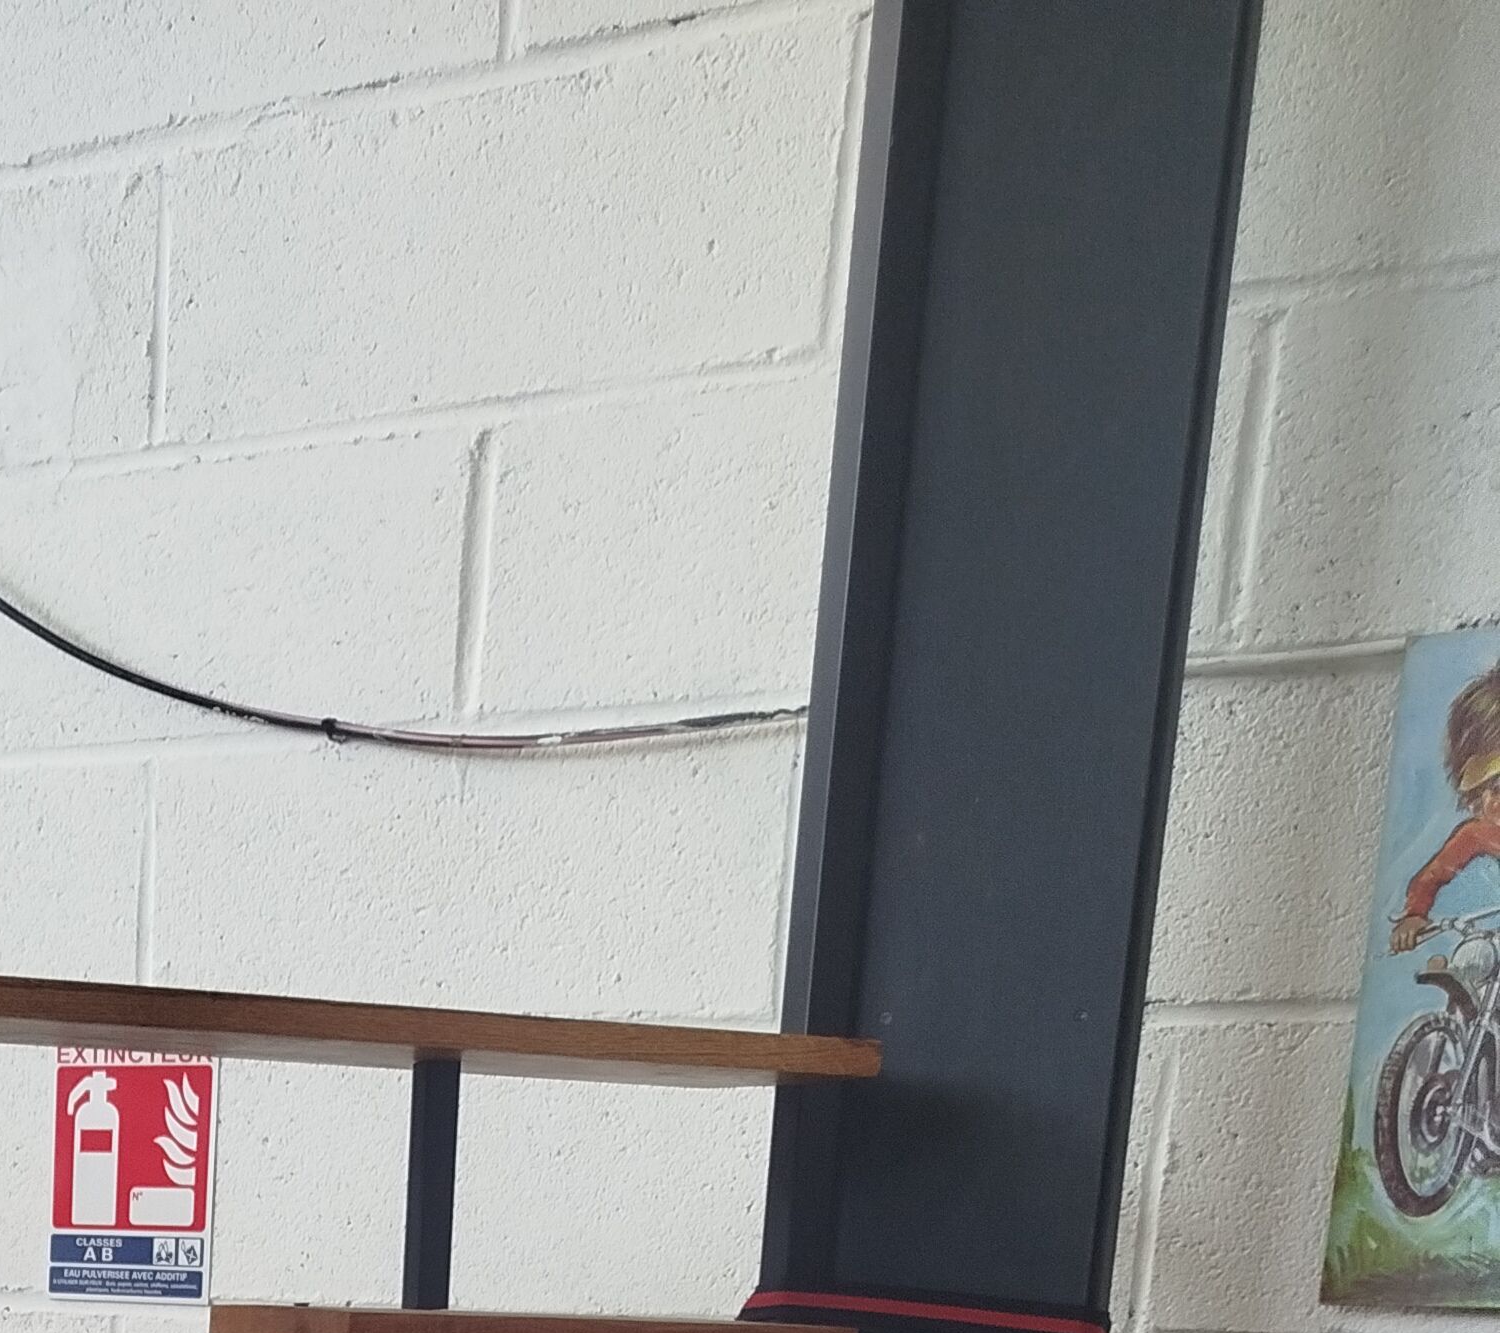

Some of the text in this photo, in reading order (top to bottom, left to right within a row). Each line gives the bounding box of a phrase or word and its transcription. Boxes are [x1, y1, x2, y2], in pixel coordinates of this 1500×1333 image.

[76, 1237, 123, 1248] CLASSES
[83, 1247, 114, 1262] A B
[63, 1268, 81, 1278] EAU
[131, 1271, 154, 1280] AVEC
[155, 1271, 188, 1282] ADDITIF
